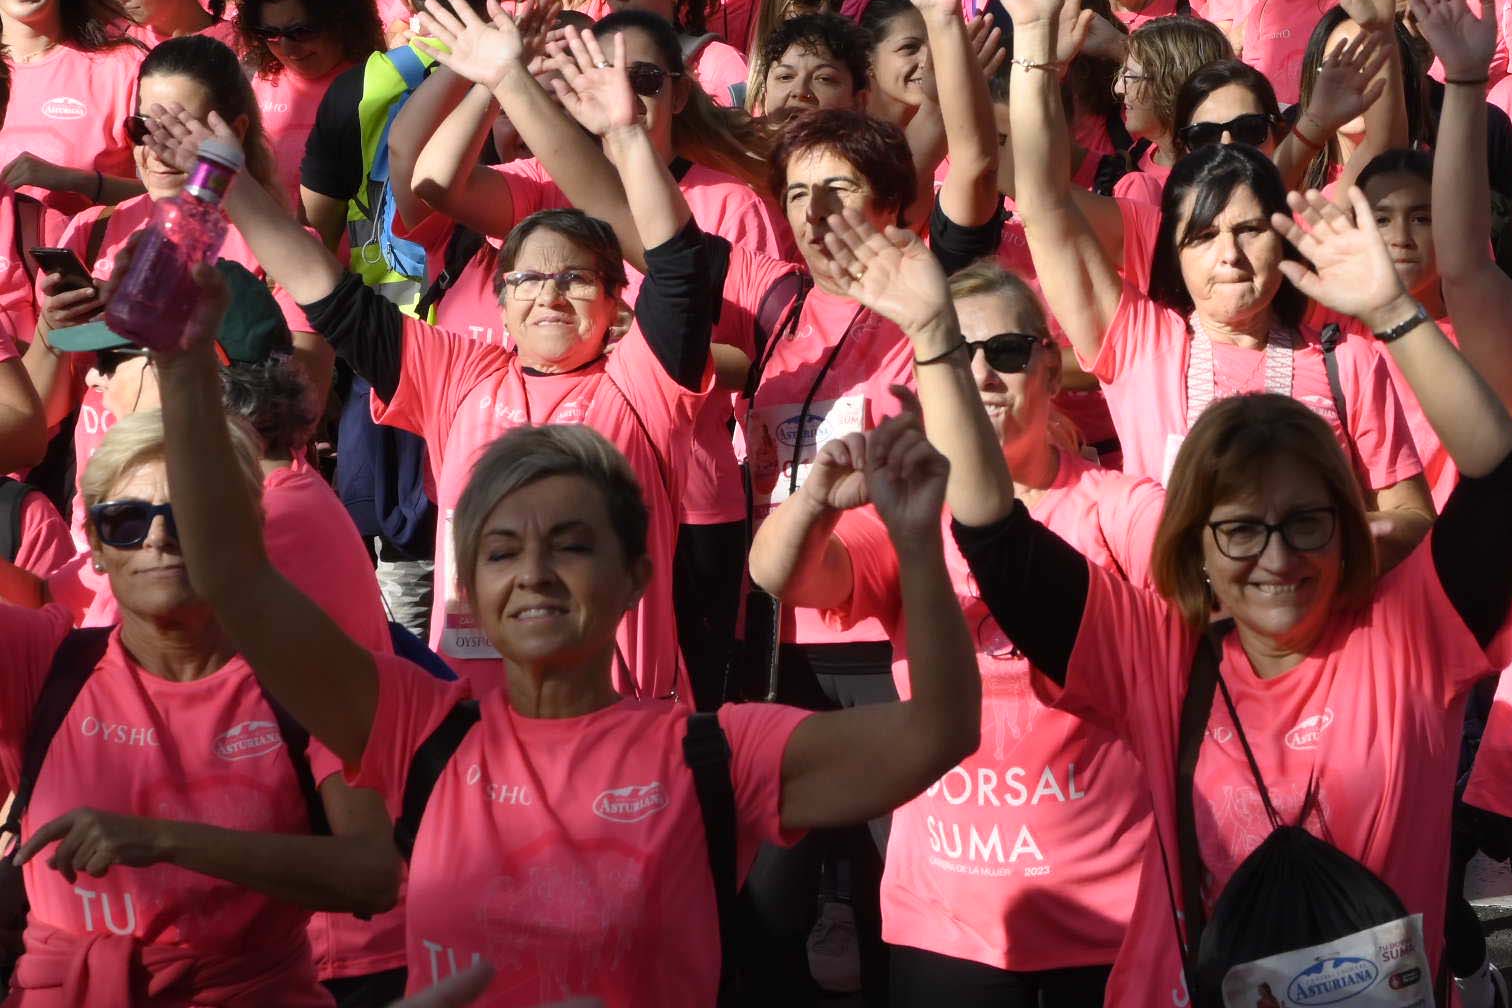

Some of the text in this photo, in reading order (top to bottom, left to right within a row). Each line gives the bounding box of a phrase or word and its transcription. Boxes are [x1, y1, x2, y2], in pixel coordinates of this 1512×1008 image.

[928, 815, 1044, 864] SUMA
[1024, 866, 1051, 877] 2023
[74, 886, 137, 936] TU
[1294, 971, 1373, 1002] ASTURIANA
